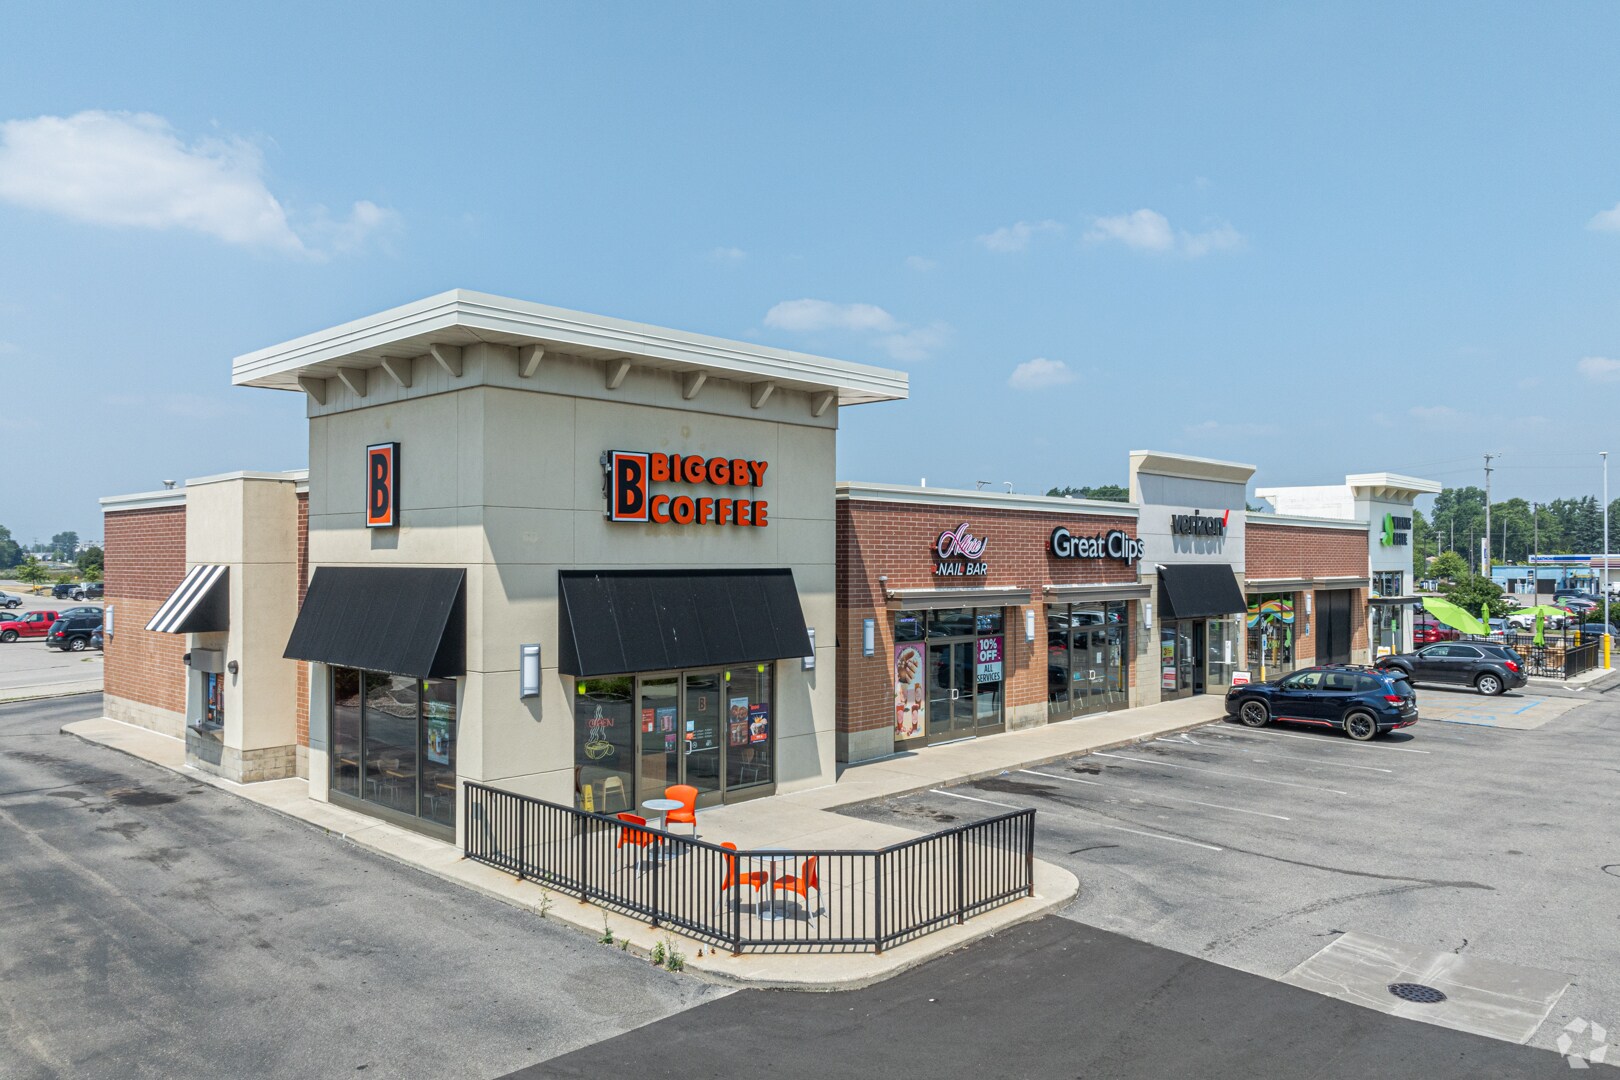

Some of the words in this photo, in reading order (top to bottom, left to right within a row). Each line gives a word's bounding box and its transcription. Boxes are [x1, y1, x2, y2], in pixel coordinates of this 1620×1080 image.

[651, 452, 769, 487] BIGGBY
[370, 452, 390, 519] B
[617, 457, 643, 516] B
[649, 493, 769, 527] COFFEE
[1171, 509, 1224, 537] verizon
[1052, 526, 1106, 559] Great
[1106, 529, 1145, 565] Clips
[938, 562, 963, 576] NAIL
[966, 562, 988, 576] BAR
[979, 638, 997, 651] 10%
[979, 650, 998, 662] OFF
[977, 671, 1000, 682] SERVICES
[983, 664, 993, 673] ALL
